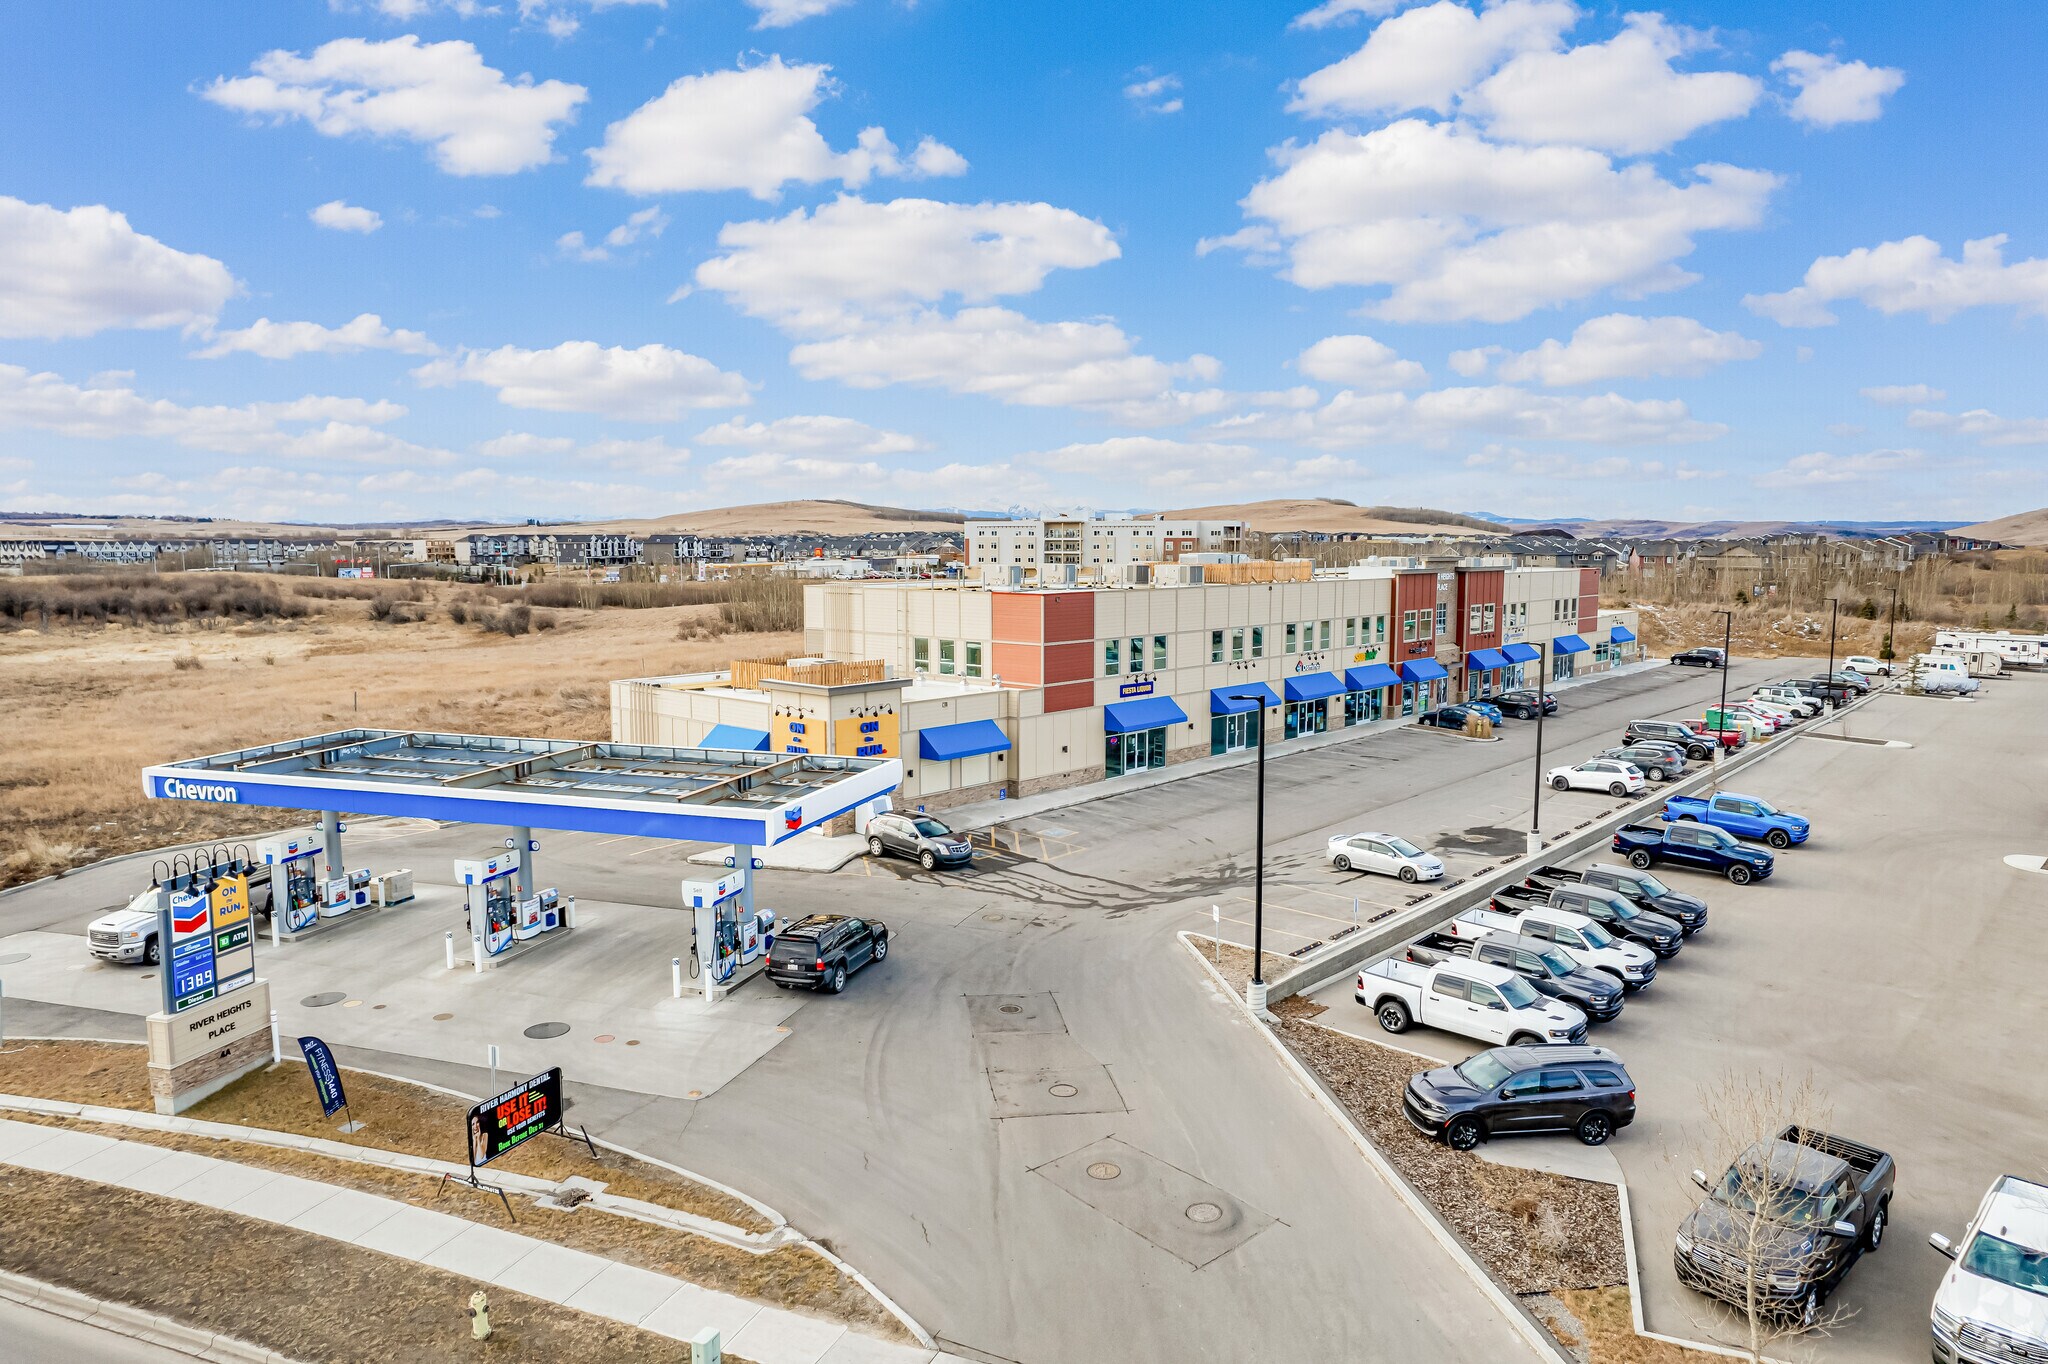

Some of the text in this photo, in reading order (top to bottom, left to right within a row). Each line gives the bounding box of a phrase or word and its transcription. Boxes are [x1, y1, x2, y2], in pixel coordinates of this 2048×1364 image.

[789, 722, 805, 734] ON
[860, 720, 879, 733] ON
[164, 778, 236, 802] Chevron
[222, 886, 237, 897] ON
[232, 931, 248, 942] ATM
[188, 994, 204, 1004] Diesel
[190, 1000, 252, 1032] RIVER HEIGHTS
[208, 1022, 236, 1039] PLACE
[480, 1073, 550, 1114] RIVER HARMONY DENTAL
[497, 1092, 529, 1120] USE IT
[498, 1096, 547, 1129] OR LOSE IT!
[507, 1110, 545, 1135] USE YOUR BENEFITS
